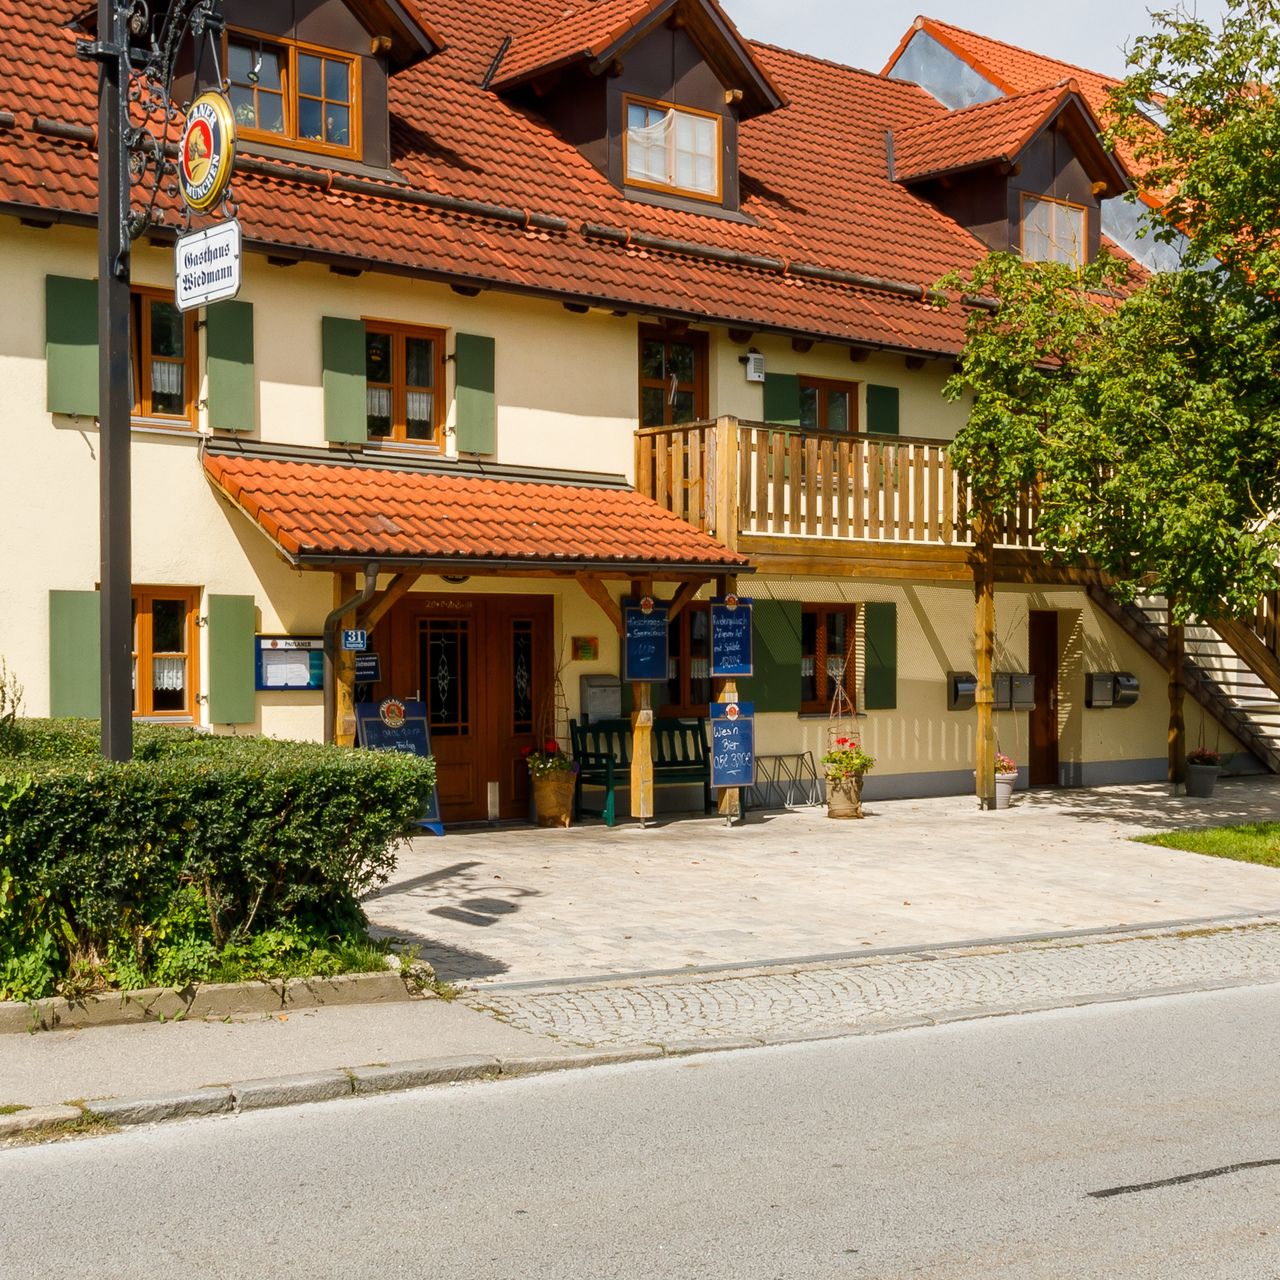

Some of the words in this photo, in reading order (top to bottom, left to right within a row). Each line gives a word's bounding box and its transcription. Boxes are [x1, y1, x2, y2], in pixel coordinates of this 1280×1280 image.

[185, 155, 220, 199] MÜNCHEN
[184, 243, 230, 269] Gasthaus
[182, 265, 232, 291] Wiedmann
[348, 631, 362, 641] 31
[722, 739, 739, 752] Bier
